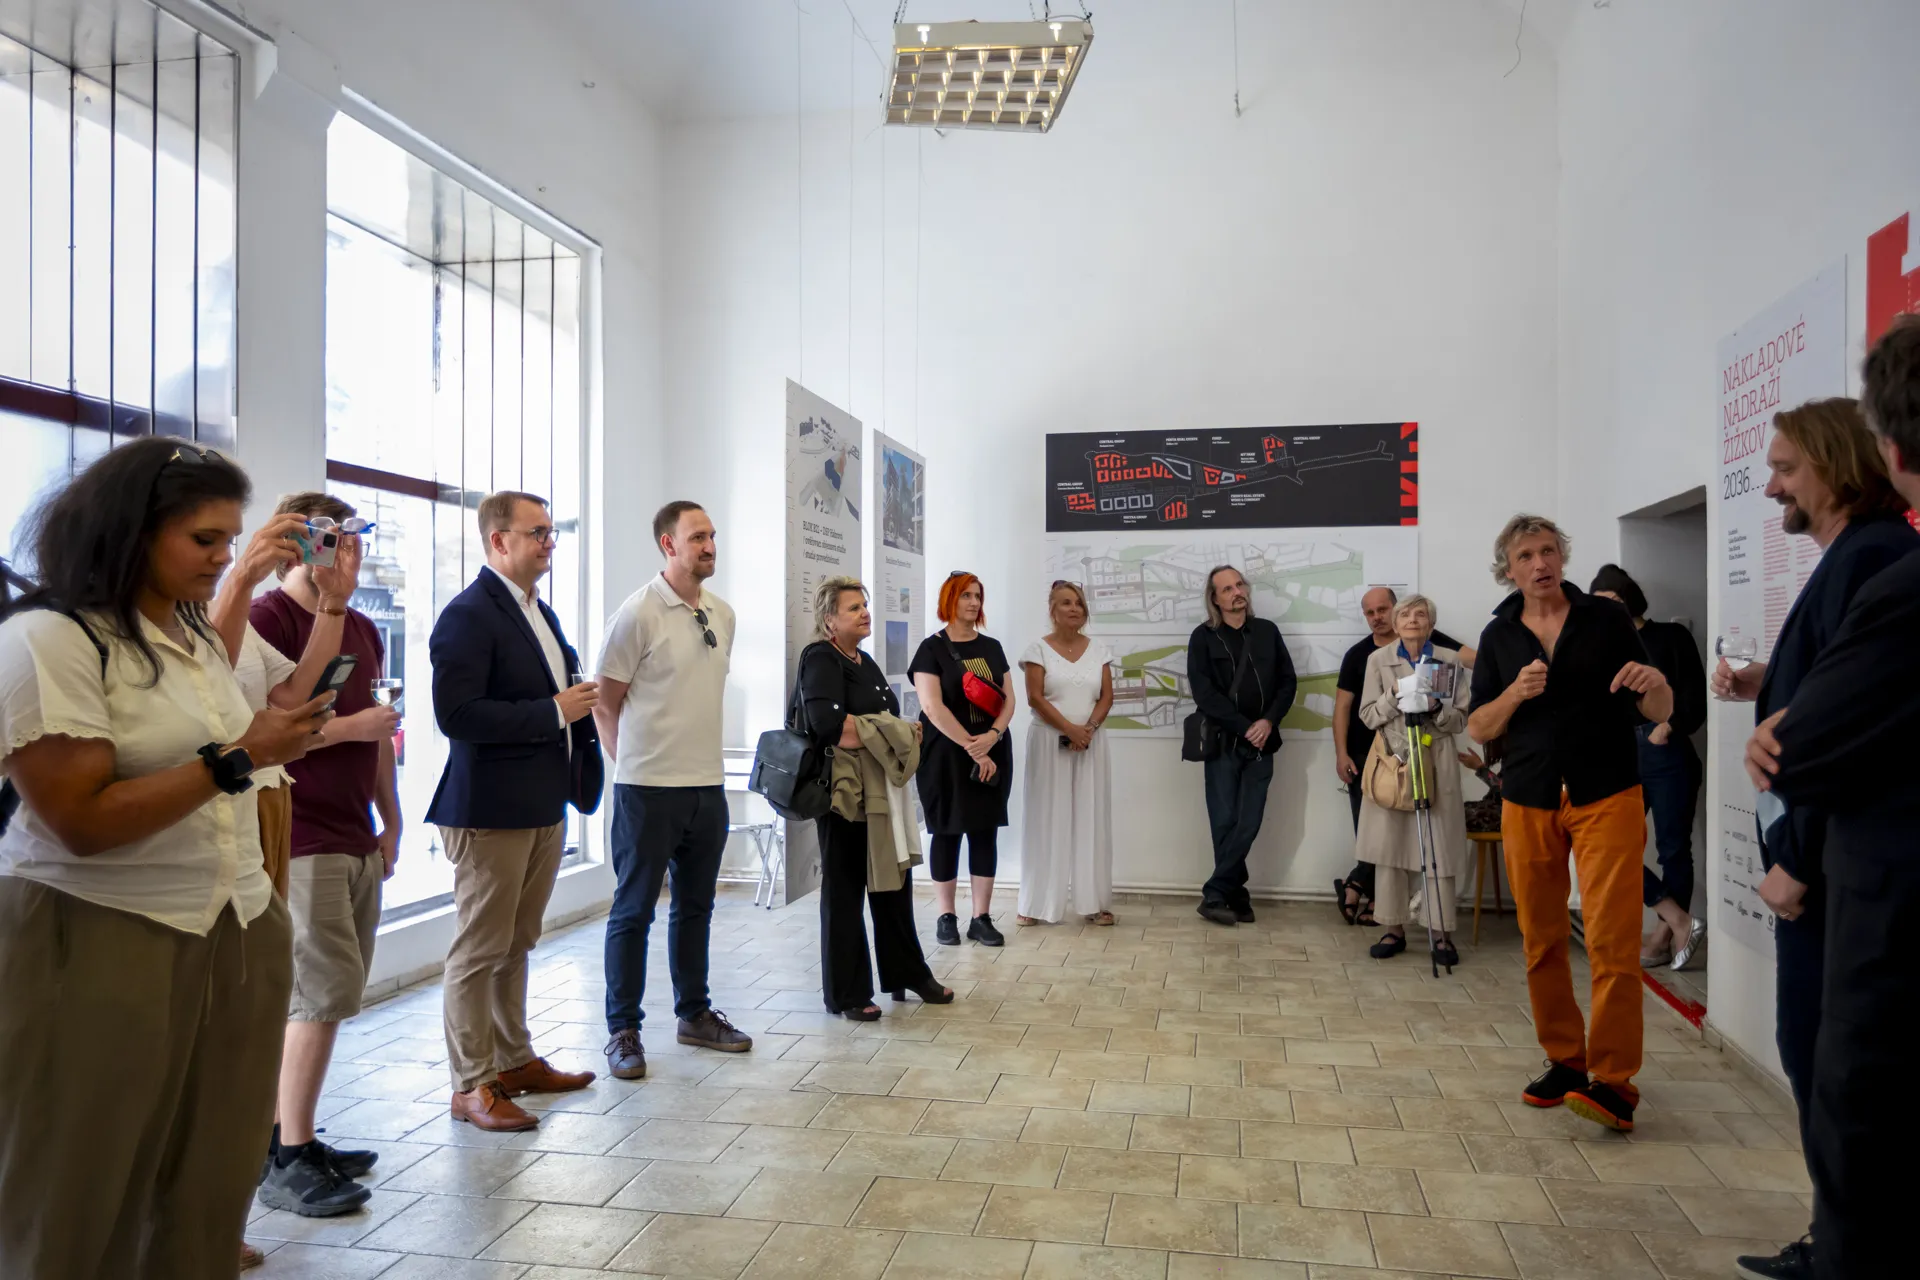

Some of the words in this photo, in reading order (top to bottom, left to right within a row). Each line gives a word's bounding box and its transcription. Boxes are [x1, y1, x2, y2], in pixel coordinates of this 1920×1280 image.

[1723, 313, 1806, 395] NÁKLADOVÉ
[1723, 368, 1782, 429] NÁDRAŽÍ
[1723, 421, 1767, 465] ŽIŽKOV
